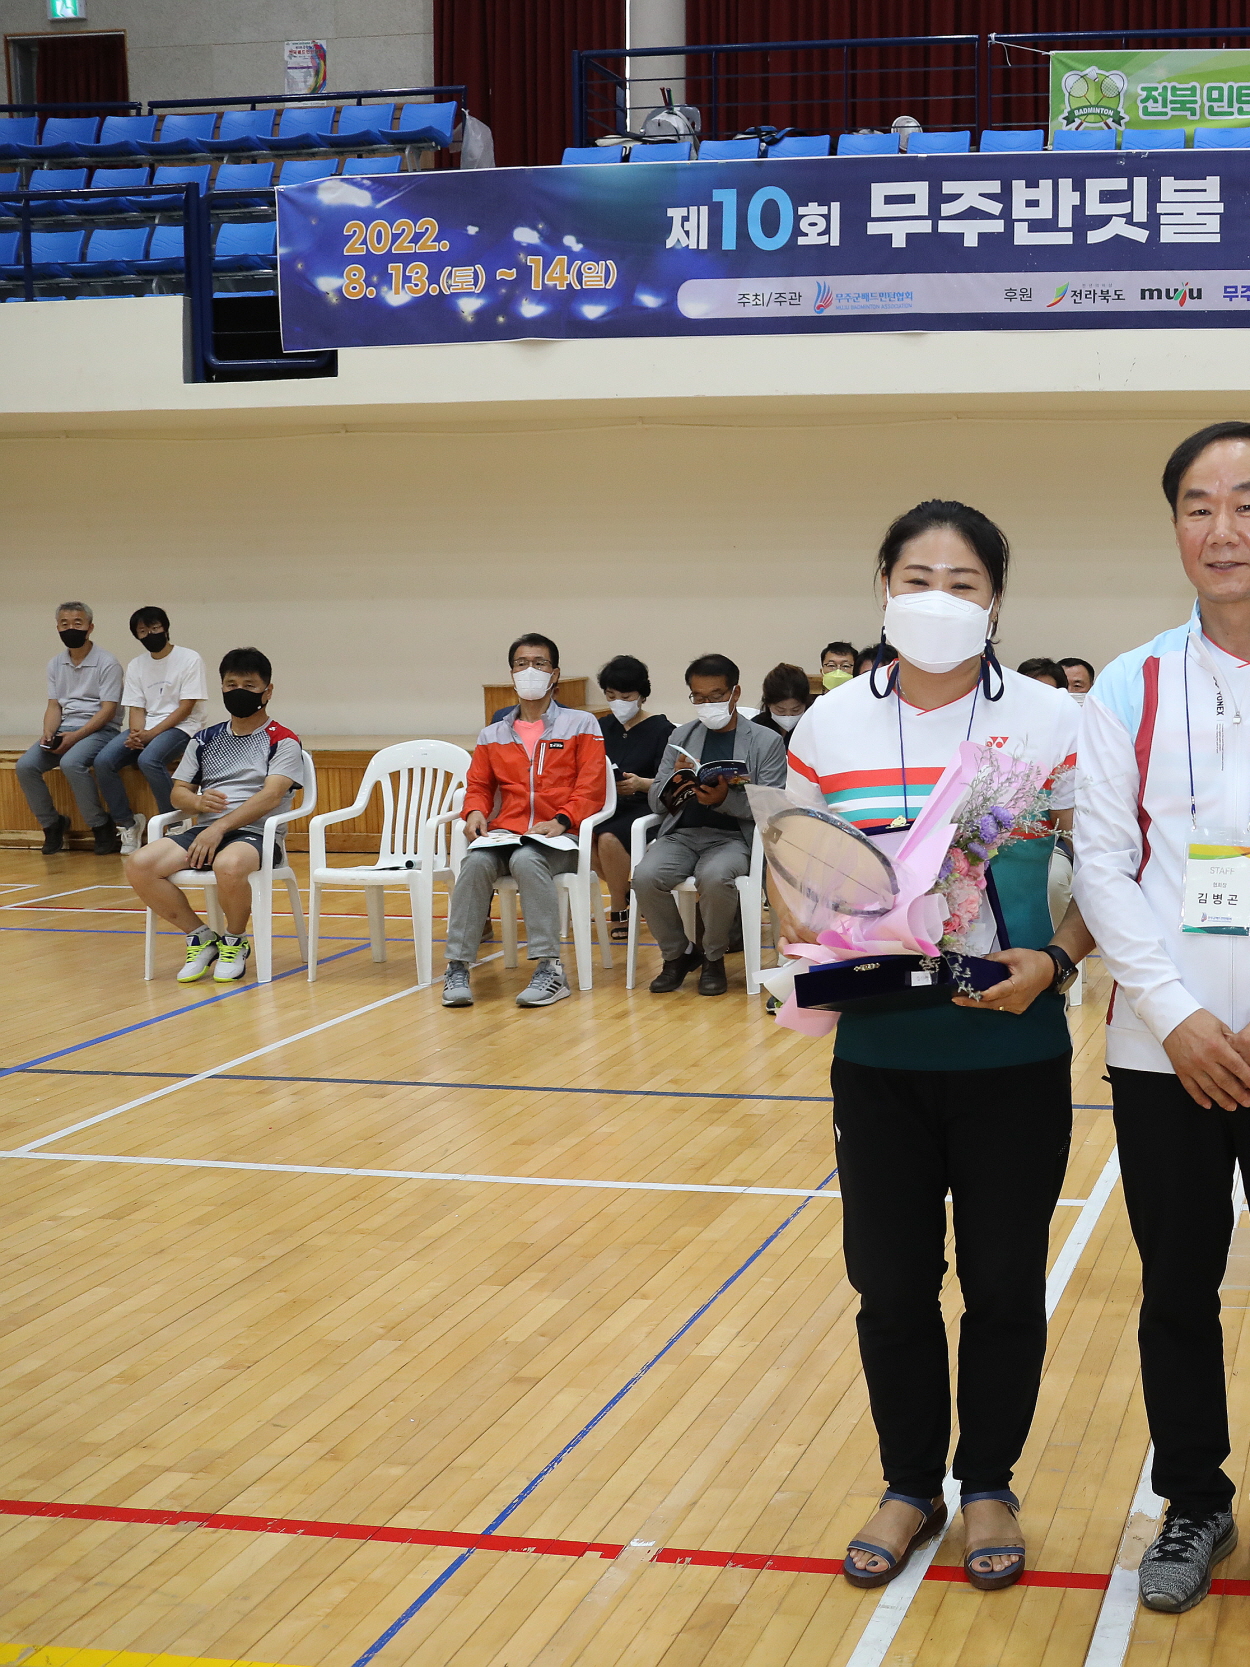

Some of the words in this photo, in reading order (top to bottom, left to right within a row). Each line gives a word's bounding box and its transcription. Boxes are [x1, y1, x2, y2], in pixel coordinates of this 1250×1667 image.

[1139, 83, 1199, 118] 전북
[1074, 107, 1114, 116] BADMINTON
[665, 185, 841, 251] 제10회
[866, 176, 1225, 248] 무주반딧불
[343, 217, 450, 255] 2022.
[342, 264, 376, 299] 8.
[388, 261, 485, 297] 13.(토)
[527, 256, 617, 291] 14(일)
[737, 292, 802, 307] 주최/주관
[835, 291, 913, 303] 무주군배드민턴협회
[1003, 287, 1033, 302] 후원
[1070, 289, 1126, 304] 전라북도
[1216, 691, 1224, 716] YONEX
[1209, 866, 1236, 875] STAFF
